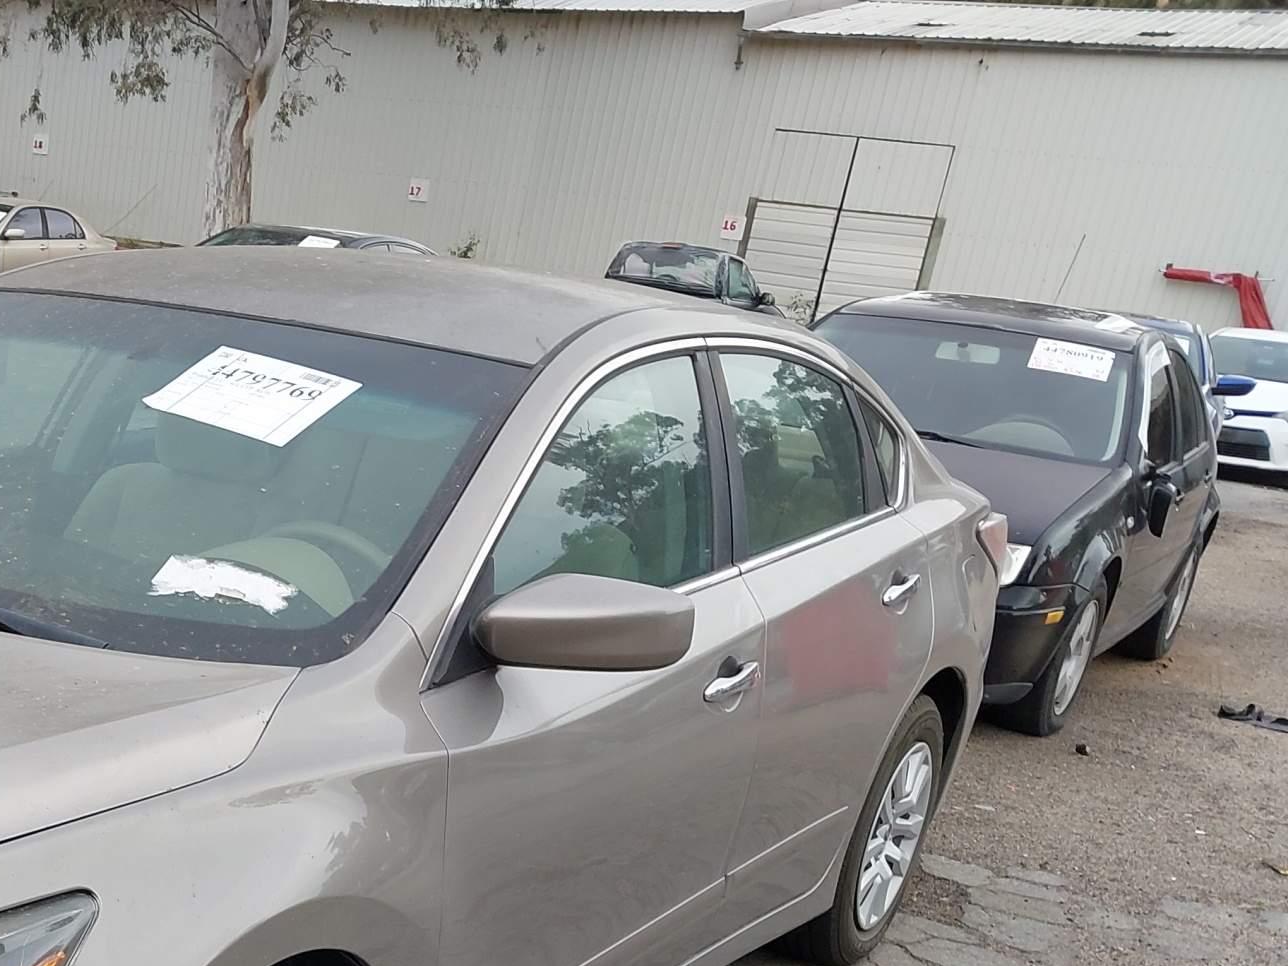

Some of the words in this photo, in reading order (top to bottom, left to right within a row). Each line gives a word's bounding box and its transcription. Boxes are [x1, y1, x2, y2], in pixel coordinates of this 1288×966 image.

[409, 186, 421, 196] 17
[722, 220, 737, 231] 16
[211, 364, 323, 401] 44797769
